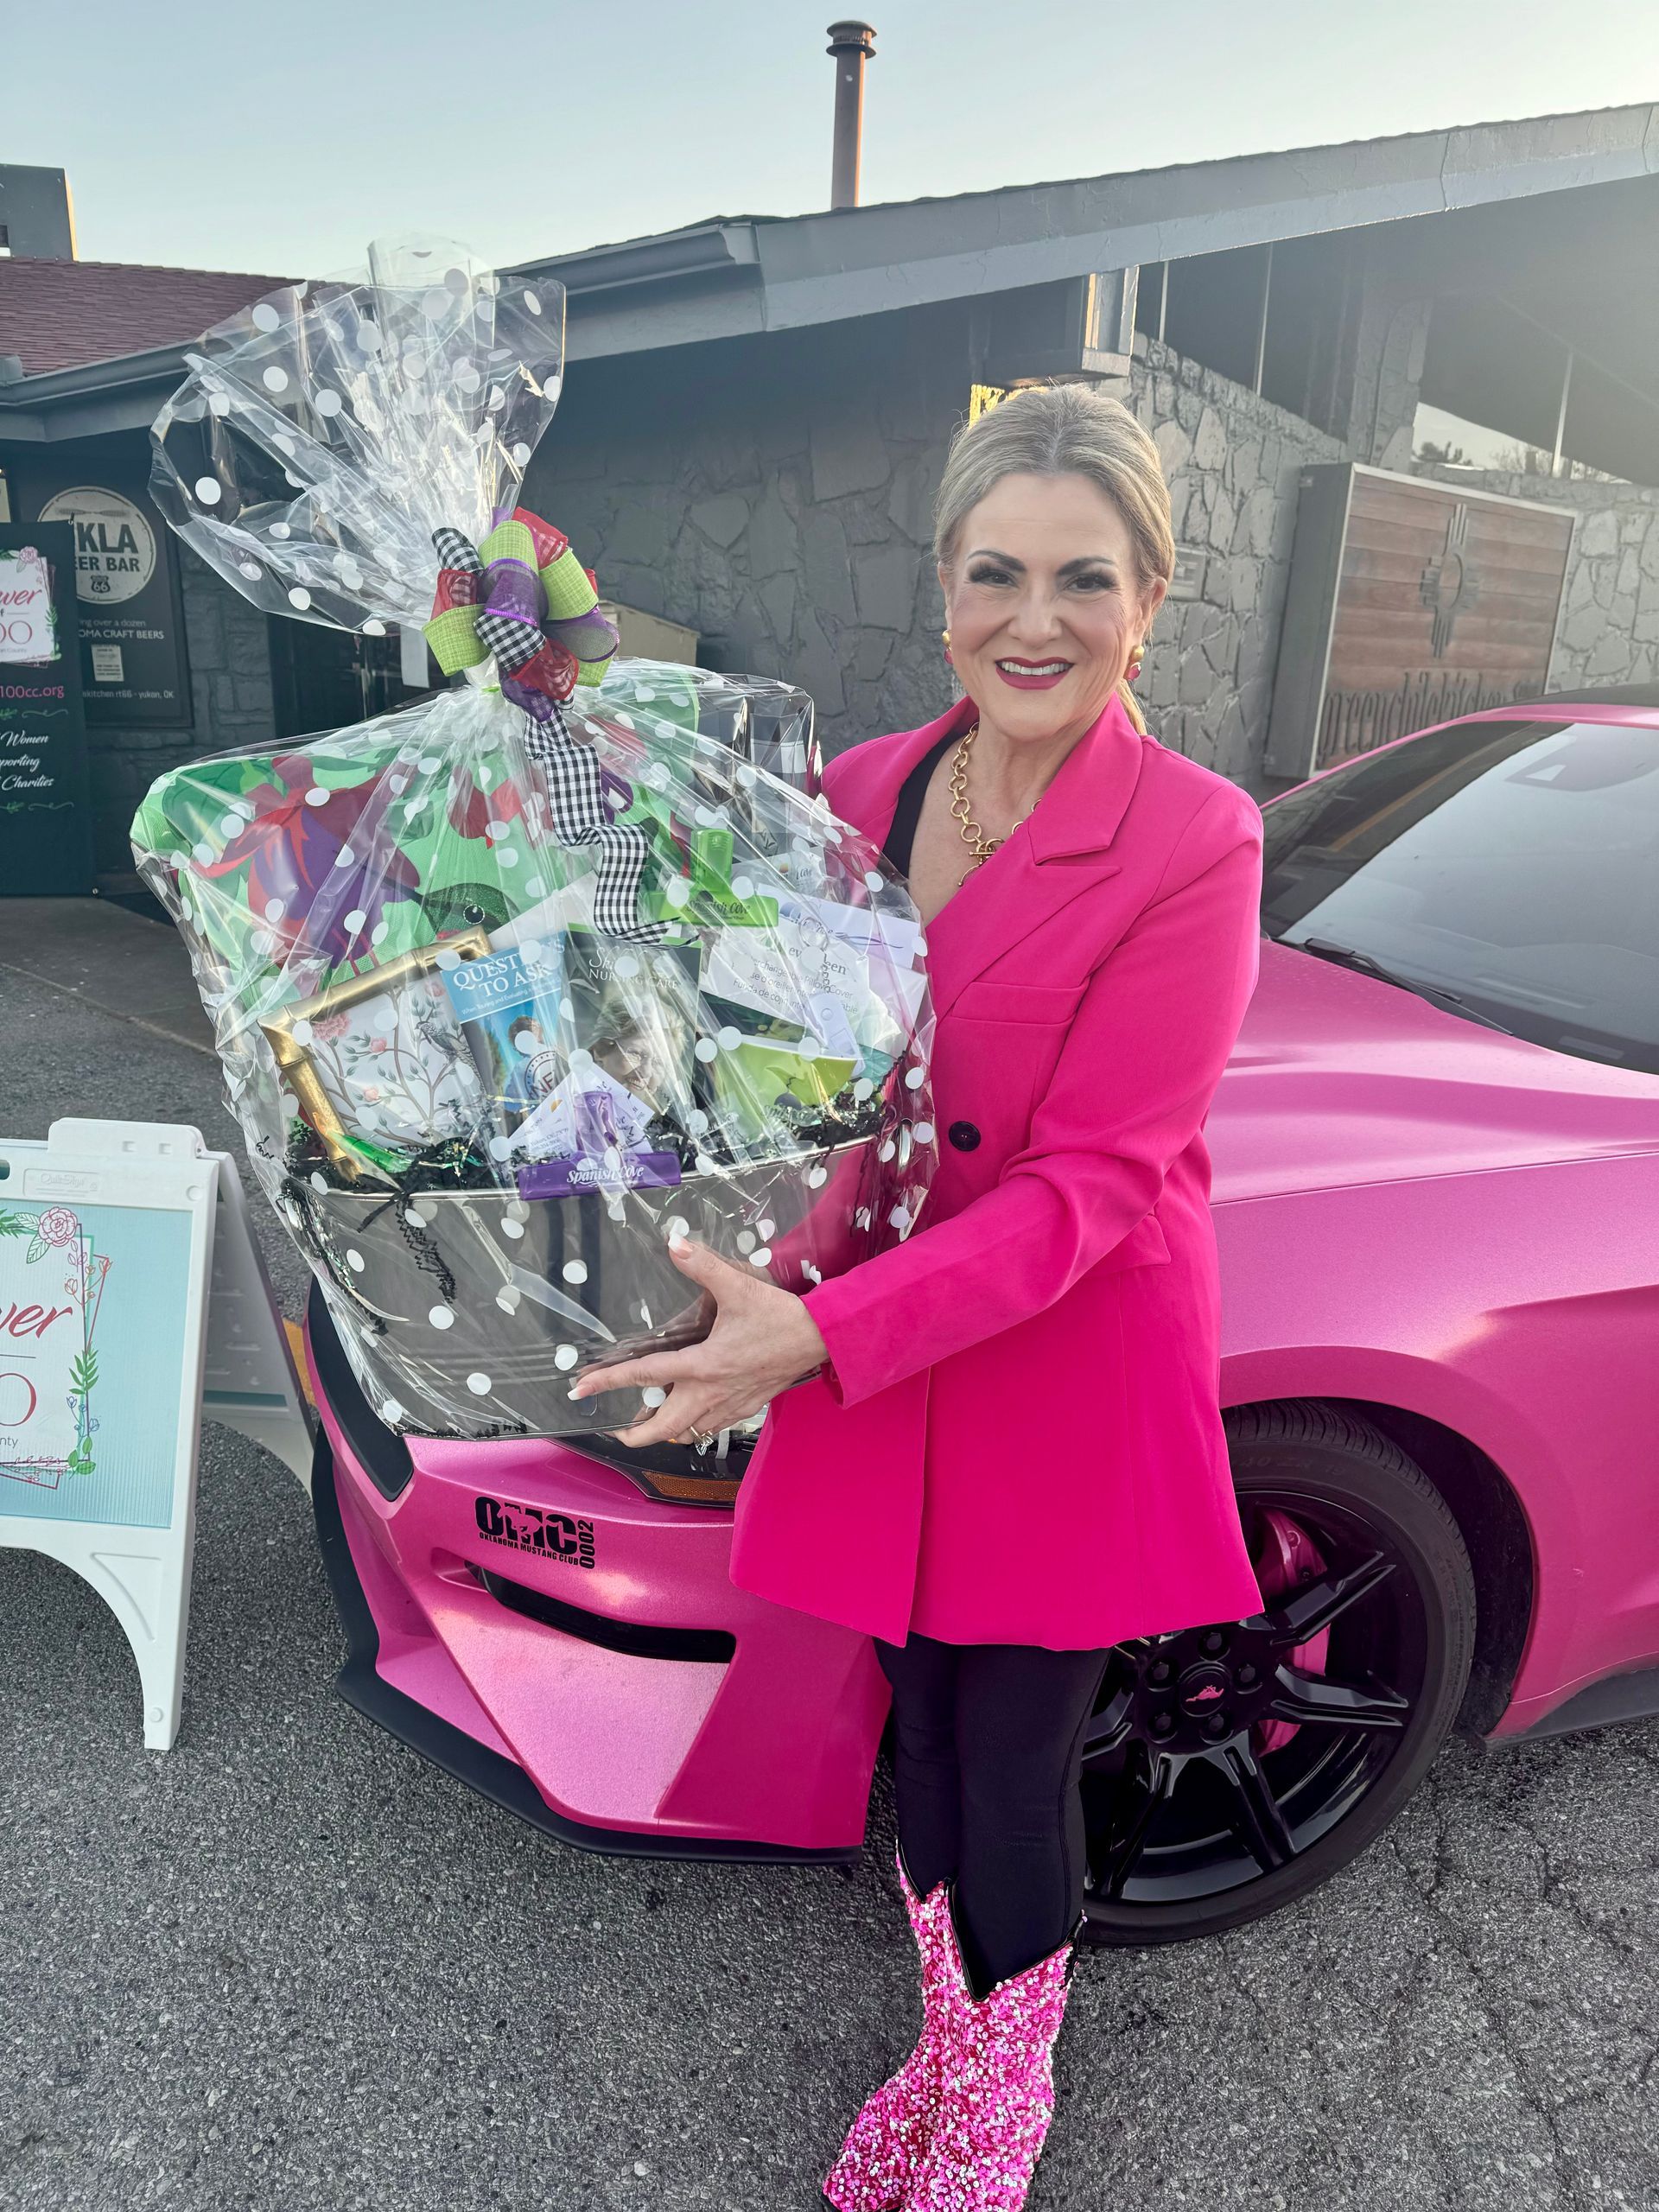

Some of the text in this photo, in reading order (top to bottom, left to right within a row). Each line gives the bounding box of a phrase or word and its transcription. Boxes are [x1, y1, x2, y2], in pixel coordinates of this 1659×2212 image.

[74, 556, 140, 572] ER BAR
[93, 582, 108, 592] 66
[121, 619, 146, 627] dozen
[103, 629, 134, 639] CRAFT
[136, 630, 165, 639] BEERS
[162, 689, 174, 699] OK
[0, 730, 49, 747] Women
[2, 774, 54, 791] Charities
[479, 976, 509, 997] TO
[513, 961, 554, 988] ASK
[829, 984, 853, 1000] Cover
[566, 1167, 617, 1185] Spanish
[619, 1165, 644, 1179] Cove
[480, 1532, 579, 1566] OKLAHOMA MUSTANG CLUB
